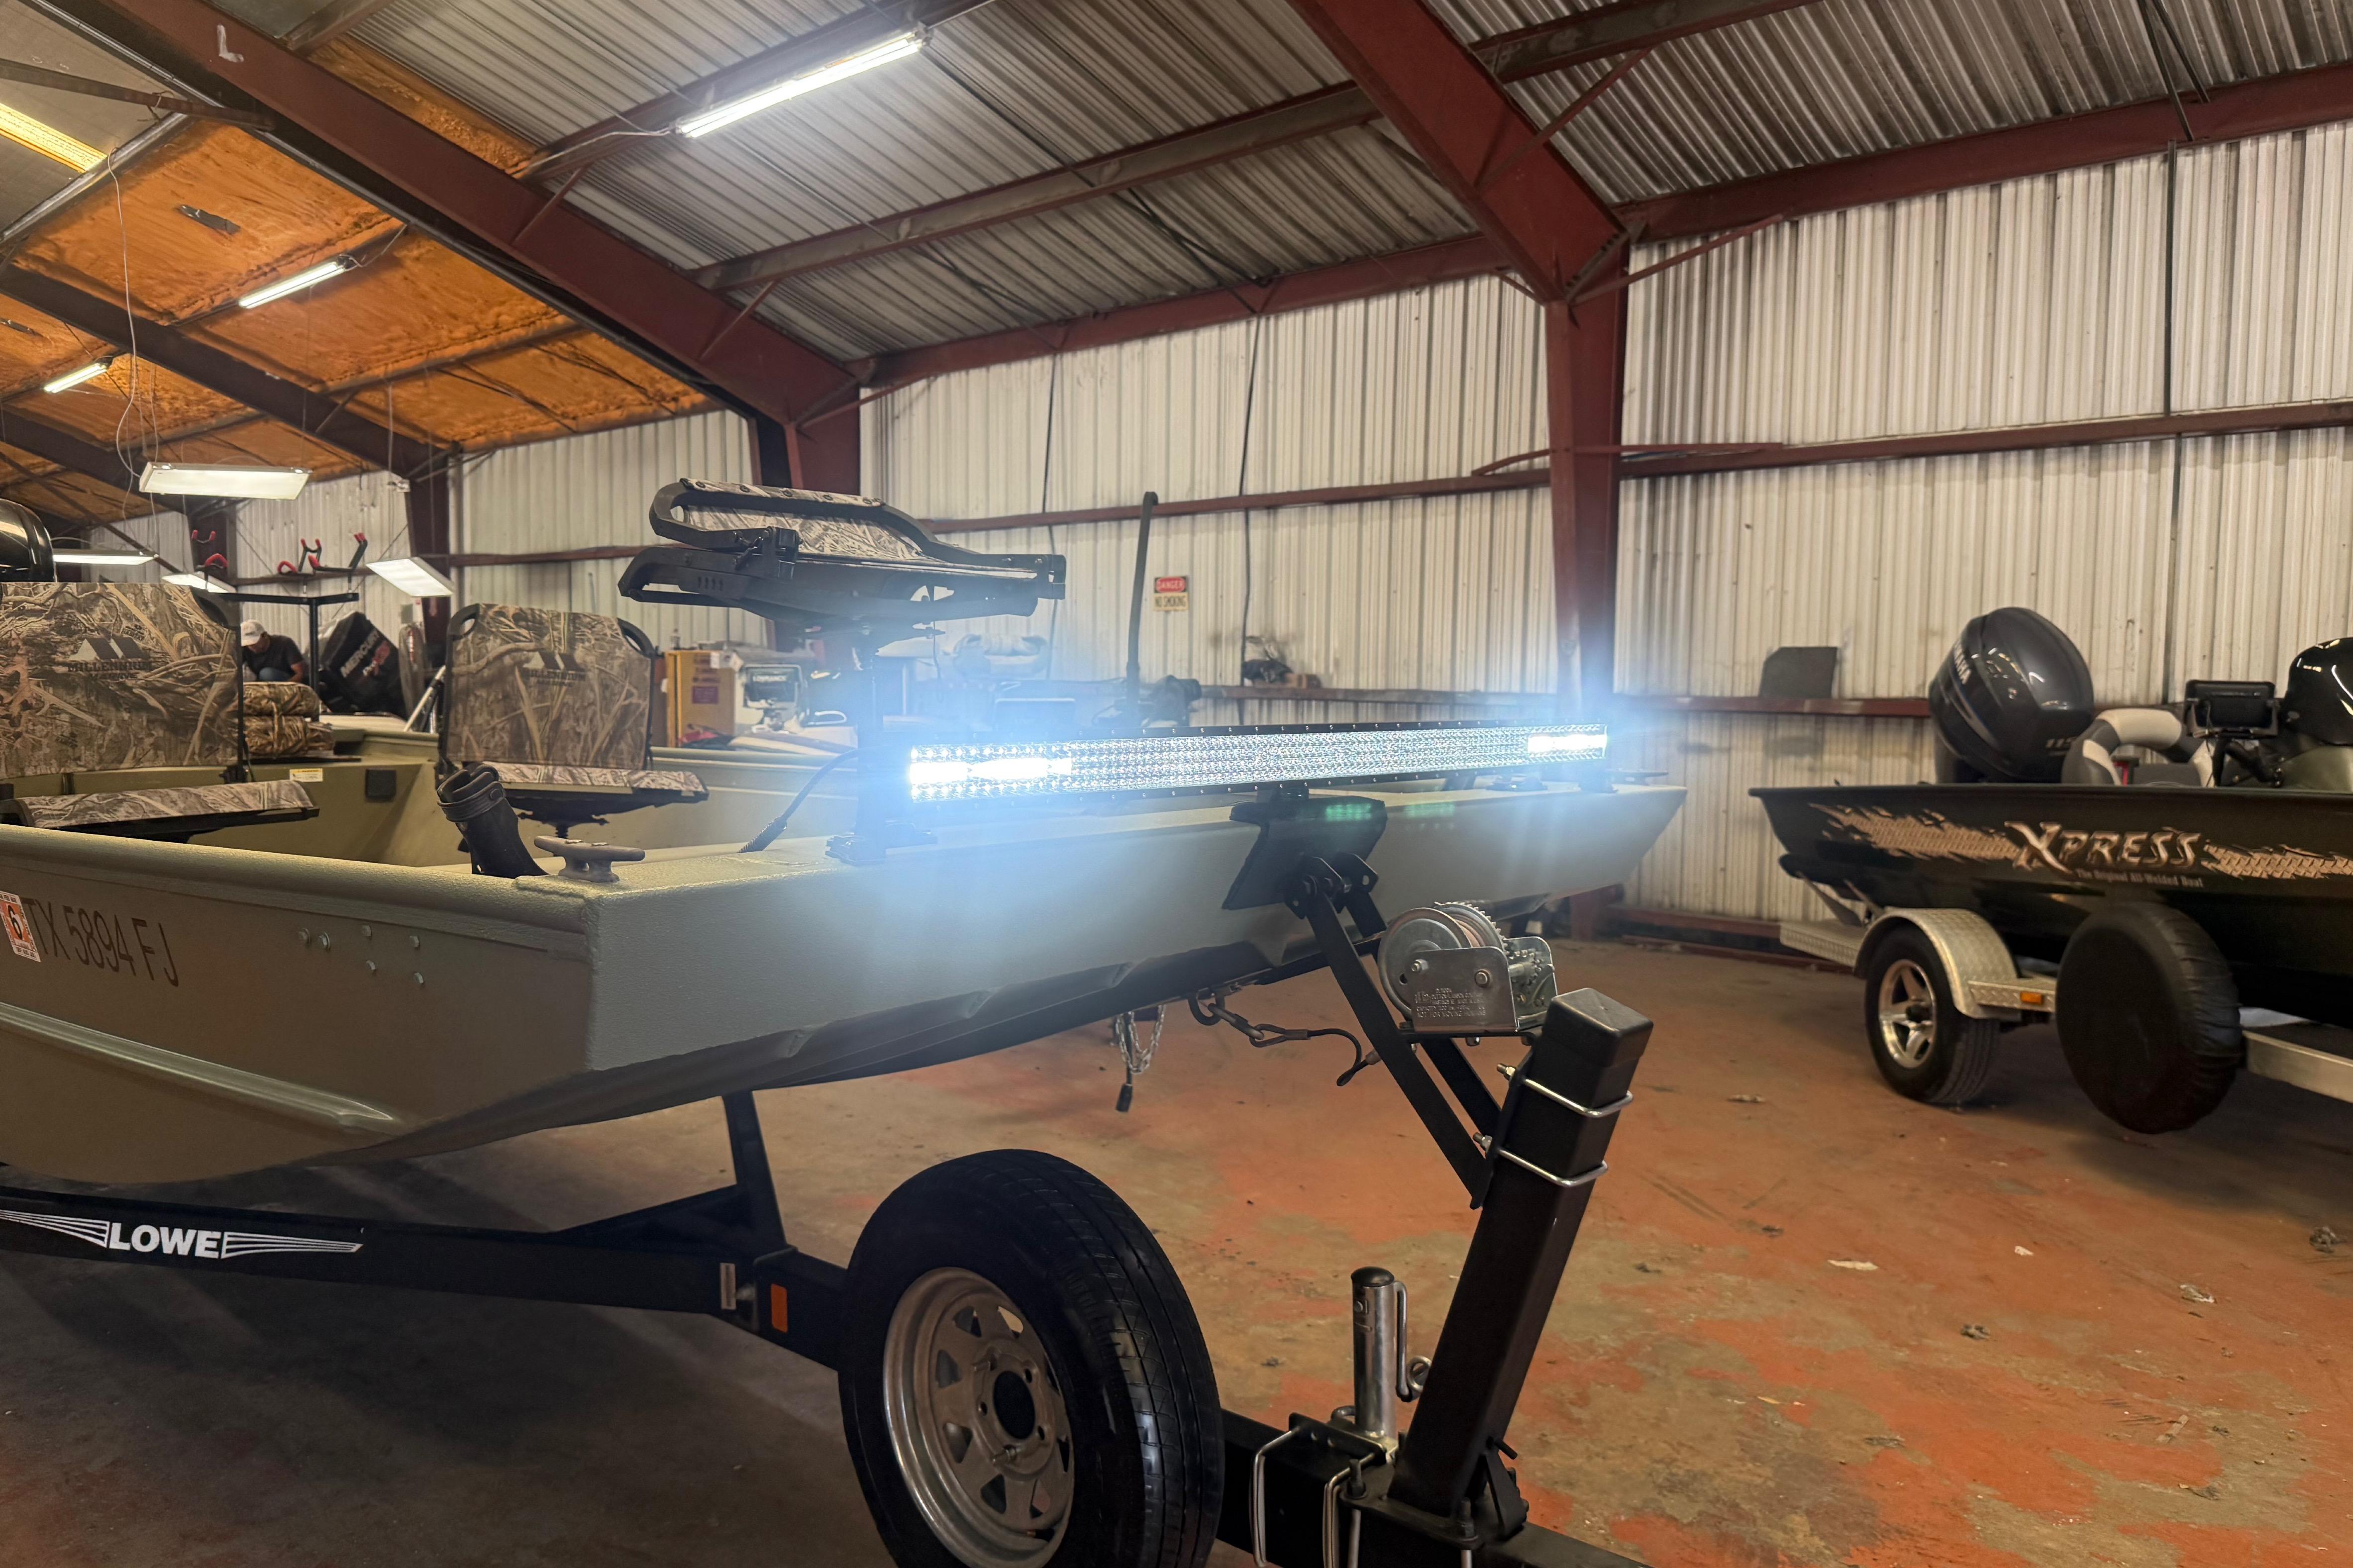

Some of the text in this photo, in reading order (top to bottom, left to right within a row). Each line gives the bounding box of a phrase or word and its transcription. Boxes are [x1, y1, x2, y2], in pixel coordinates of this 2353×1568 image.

[1155, 580, 1184, 589] DANGER
[2004, 821, 2201, 875] XPRESS
[8, 905, 23, 940] 6
[20, 897, 71, 960] TX
[63, 905, 136, 977] 5894
[109, 1222, 221, 1259] LOWE
